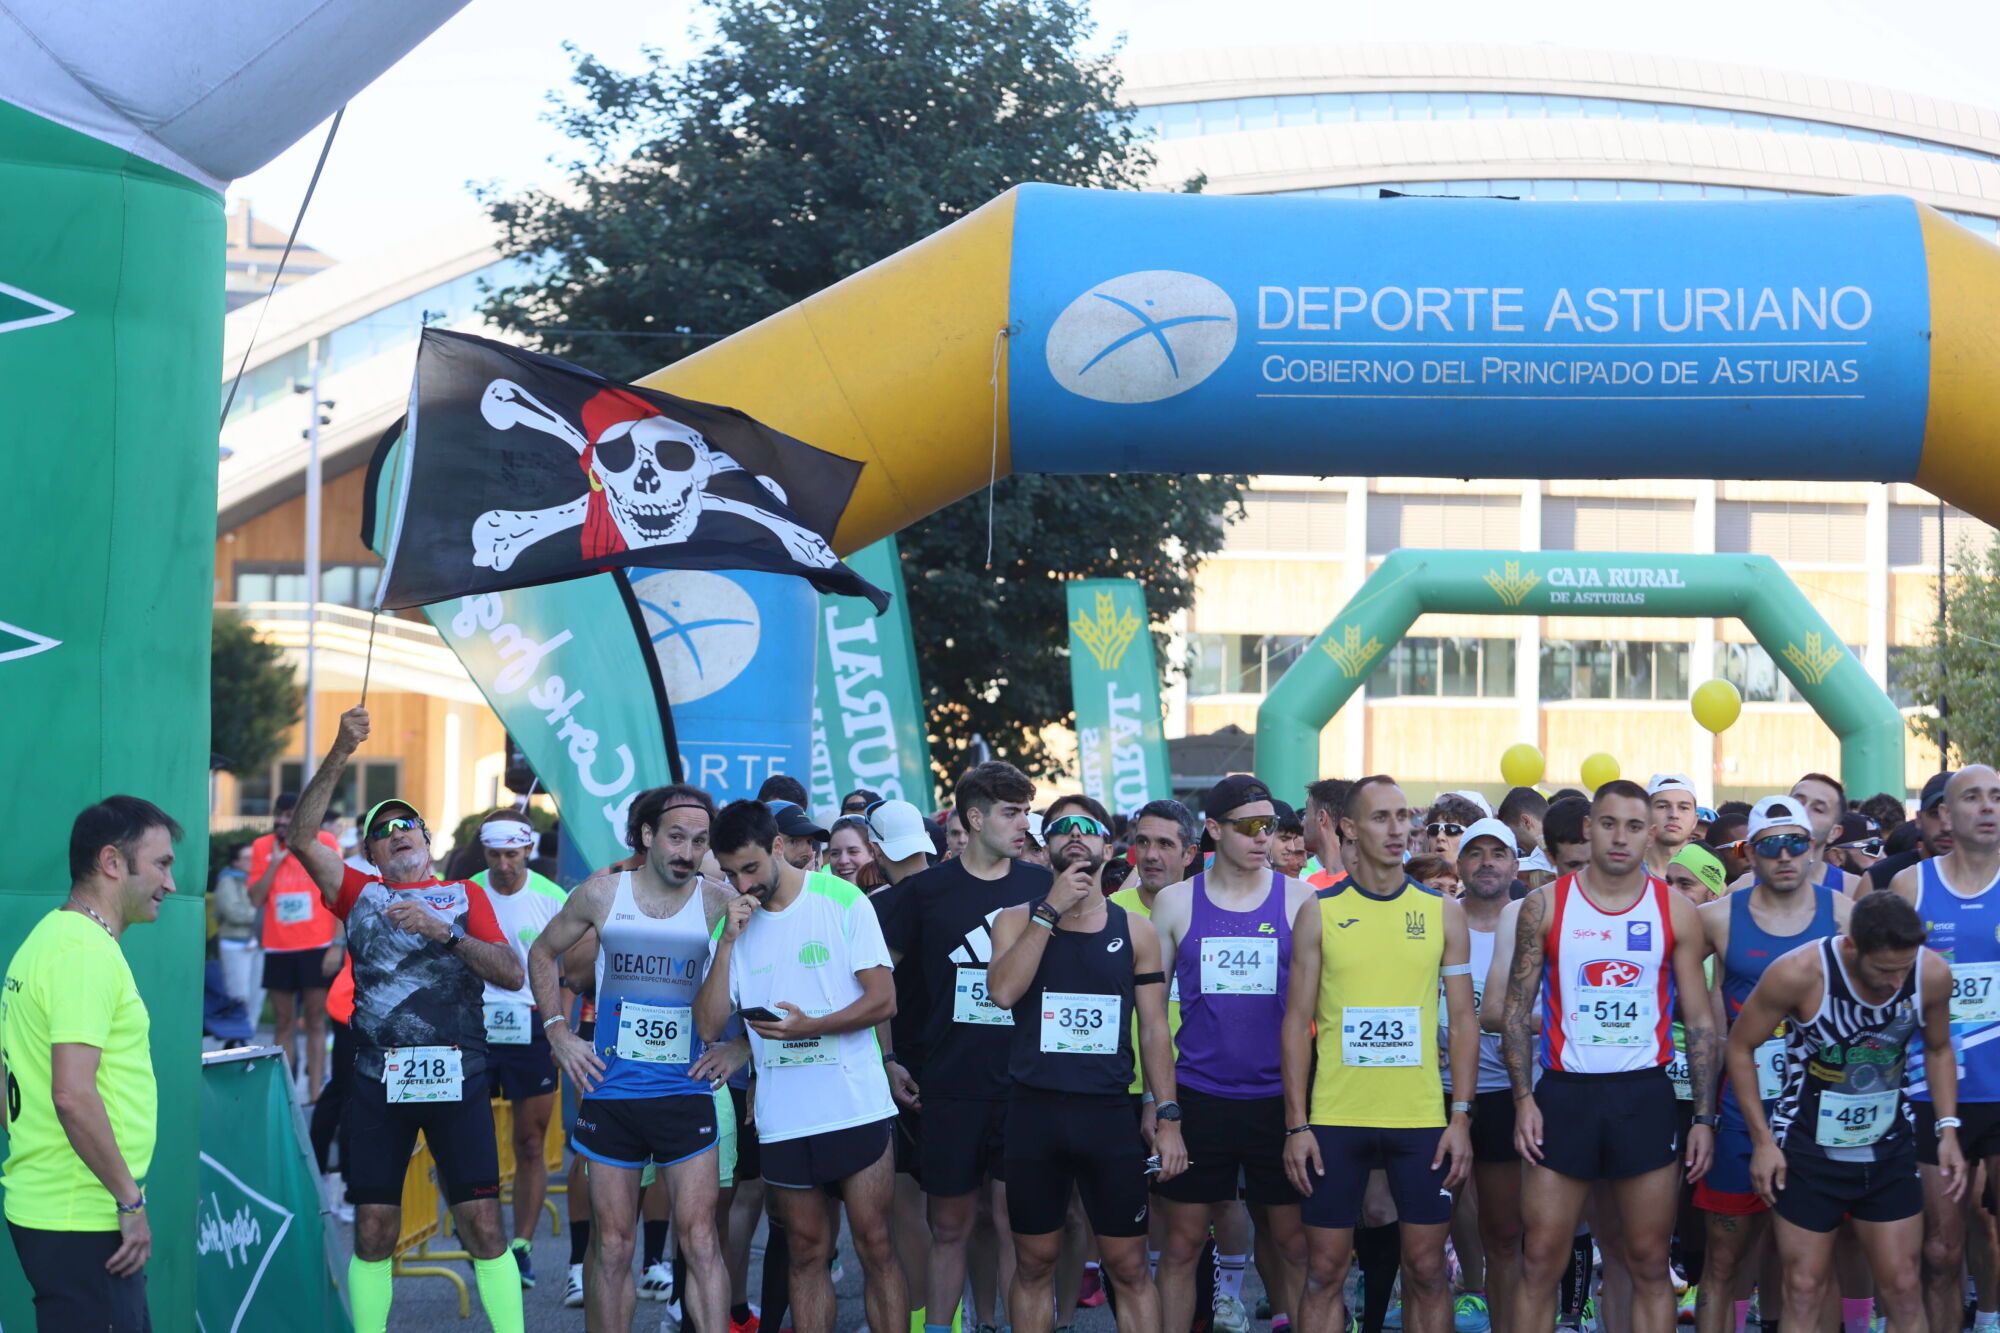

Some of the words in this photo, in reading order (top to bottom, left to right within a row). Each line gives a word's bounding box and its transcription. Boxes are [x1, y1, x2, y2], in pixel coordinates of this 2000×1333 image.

[1258, 286, 1525, 332] DEPORTE
[1544, 285, 1873, 332] ASTURIANO
[1262, 354, 1414, 384] GOBIERNO
[1422, 360, 1475, 384] DEL
[1482, 356, 1654, 385] PRINCIPADO
[1661, 361, 1699, 385] DE
[1709, 356, 1859, 384] ASTURIAS
[1547, 567, 1604, 588] CAJA
[1607, 568, 1687, 588] RURAL
[1550, 591, 1571, 604] DE
[1573, 591, 1645, 604] ASTURIAS
[1217, 950, 1262, 969] 244
[494, 1010, 515, 1025] 54
[1059, 1007, 1103, 1028] 353
[1594, 1001, 1638, 1021] 514
[635, 1018, 678, 1040] 356
[1359, 1020, 1404, 1041] 243
[644, 1039, 666, 1047] CHUS
[782, 1041, 819, 1049] LISANDRO
[403, 1059, 446, 1078] 218
[1836, 1104, 1879, 1126] 481
